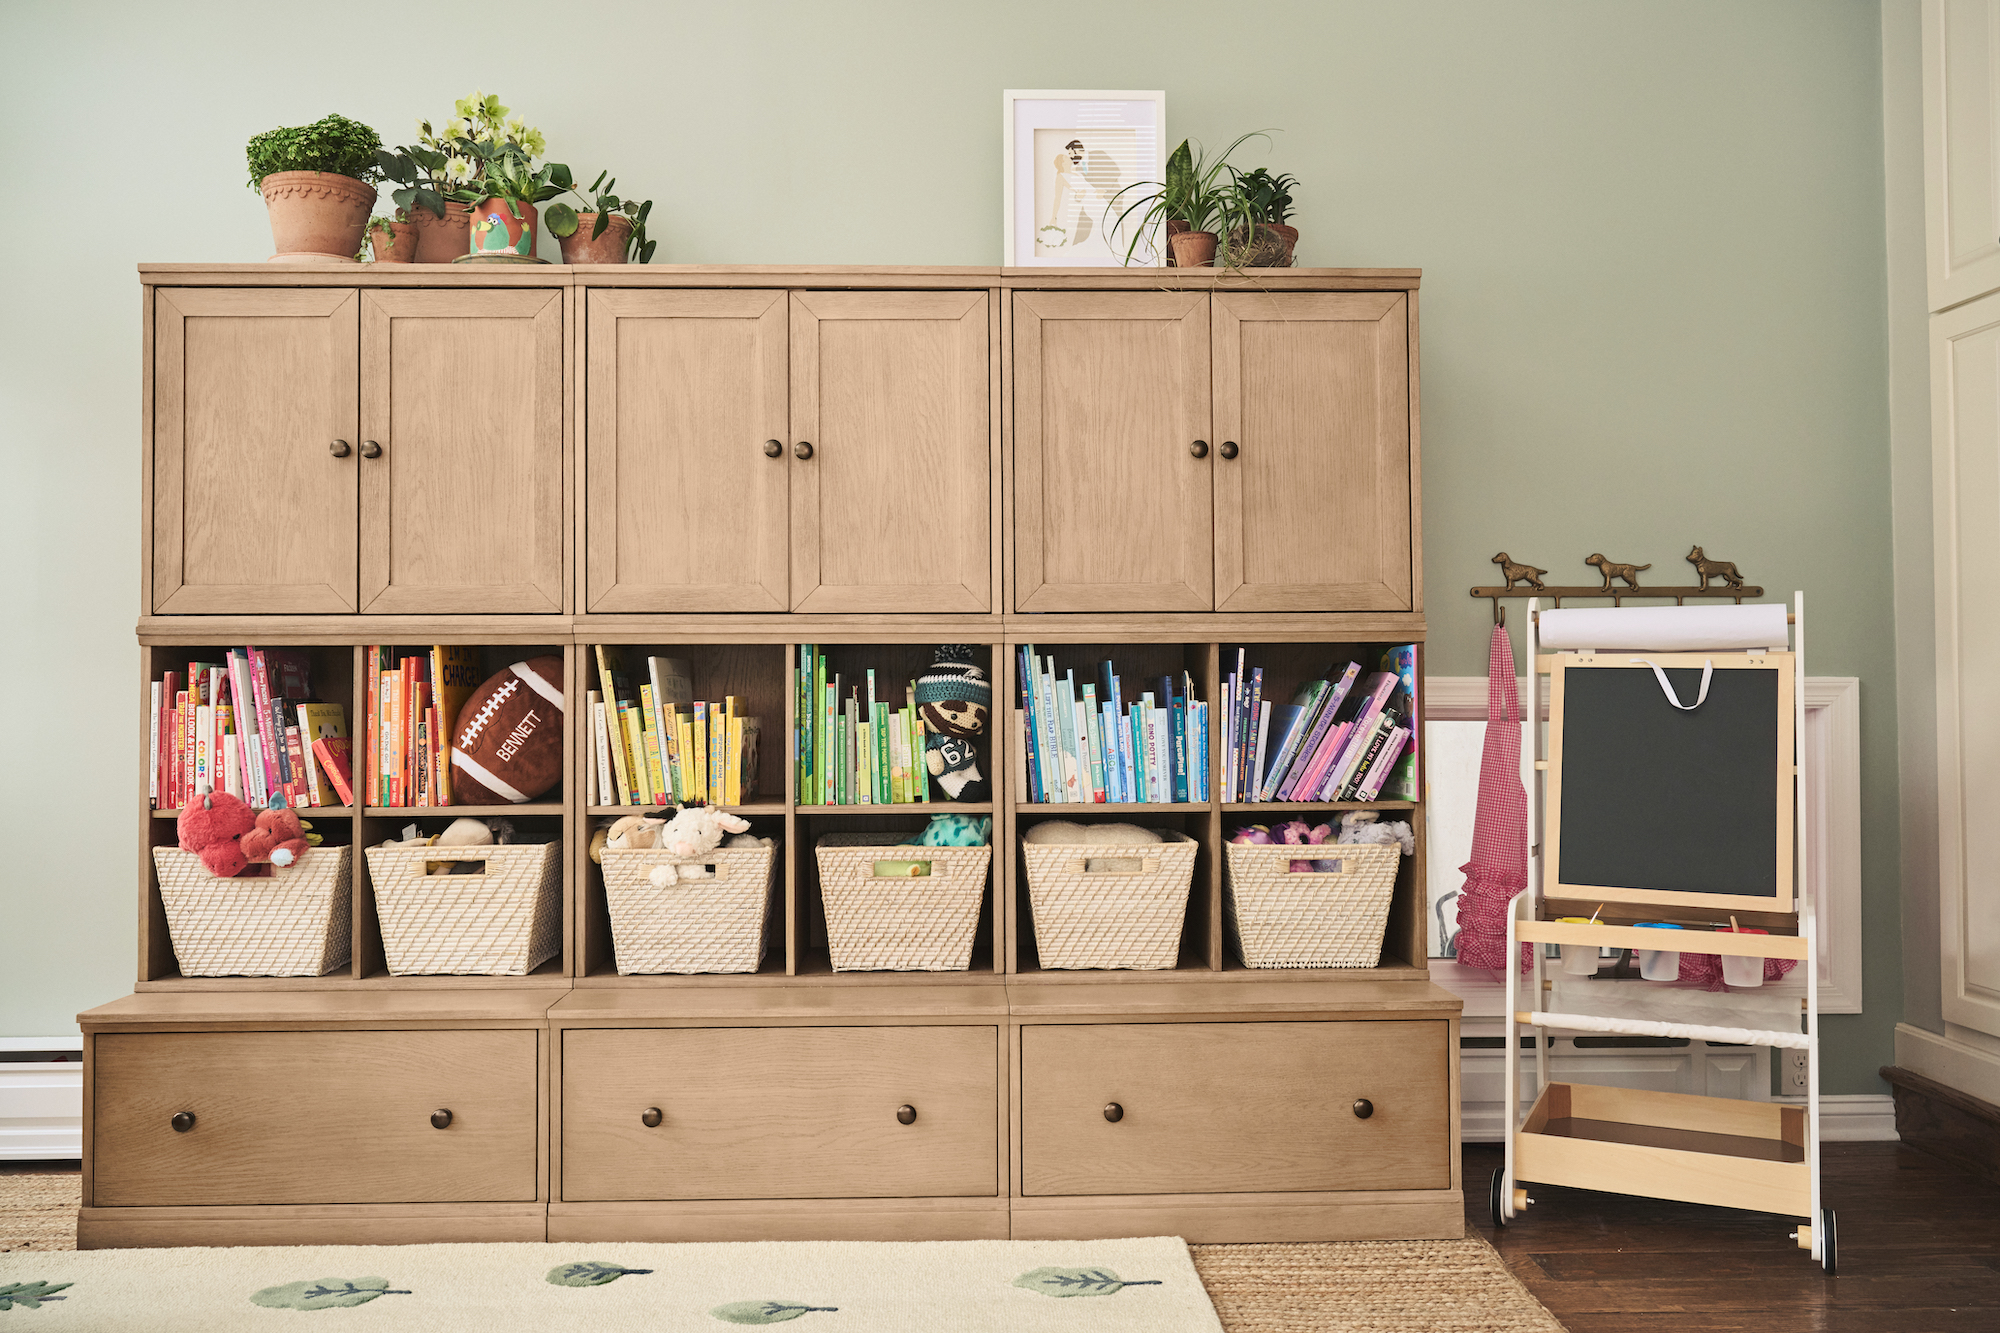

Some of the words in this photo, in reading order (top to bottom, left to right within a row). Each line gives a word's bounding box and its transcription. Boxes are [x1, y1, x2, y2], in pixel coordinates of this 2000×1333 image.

[443, 664, 479, 687] CHARGE!
[1253, 687, 1261, 702] WE'RE
[643, 697, 654, 722] HAPPY
[1252, 702, 1260, 721] GOING
[1317, 696, 1341, 730] 5-MINUTE
[263, 709, 274, 741] 5-Minute
[391, 724, 399, 742] Piggy
[495, 709, 542, 763] BENNETT
[1354, 716, 1373, 742] Forever
[646, 724, 659, 760] BIRTHDAY
[1049, 736, 1057, 759] BIBLE
[1249, 730, 1258, 747] SANTA
[1295, 733, 1304, 742] Lost
[1300, 731, 1320, 762] STORIES
[1371, 739, 1383, 753] LOVE
[268, 741, 277, 763] Stories
[418, 746, 426, 768] Spooky
[667, 720, 675, 736] Little
[673, 777, 682, 794] Could
[902, 745, 910, 766] Farm
[940, 739, 974, 767] 62
[1108, 748, 1116, 772] ABCs
[1176, 735, 1185, 776] PorcuPine!
[1284, 752, 1295, 767] Found
[1367, 752, 1375, 761] MY
[1390, 746, 1401, 761] alphabet
[324, 760, 343, 786] CORDUROY
[1360, 760, 1370, 772] tutu
[1382, 760, 1393, 773] family
[293, 777, 298, 786] On
[1353, 772, 1364, 784] TOO!
[1378, 773, 1386, 783] band
